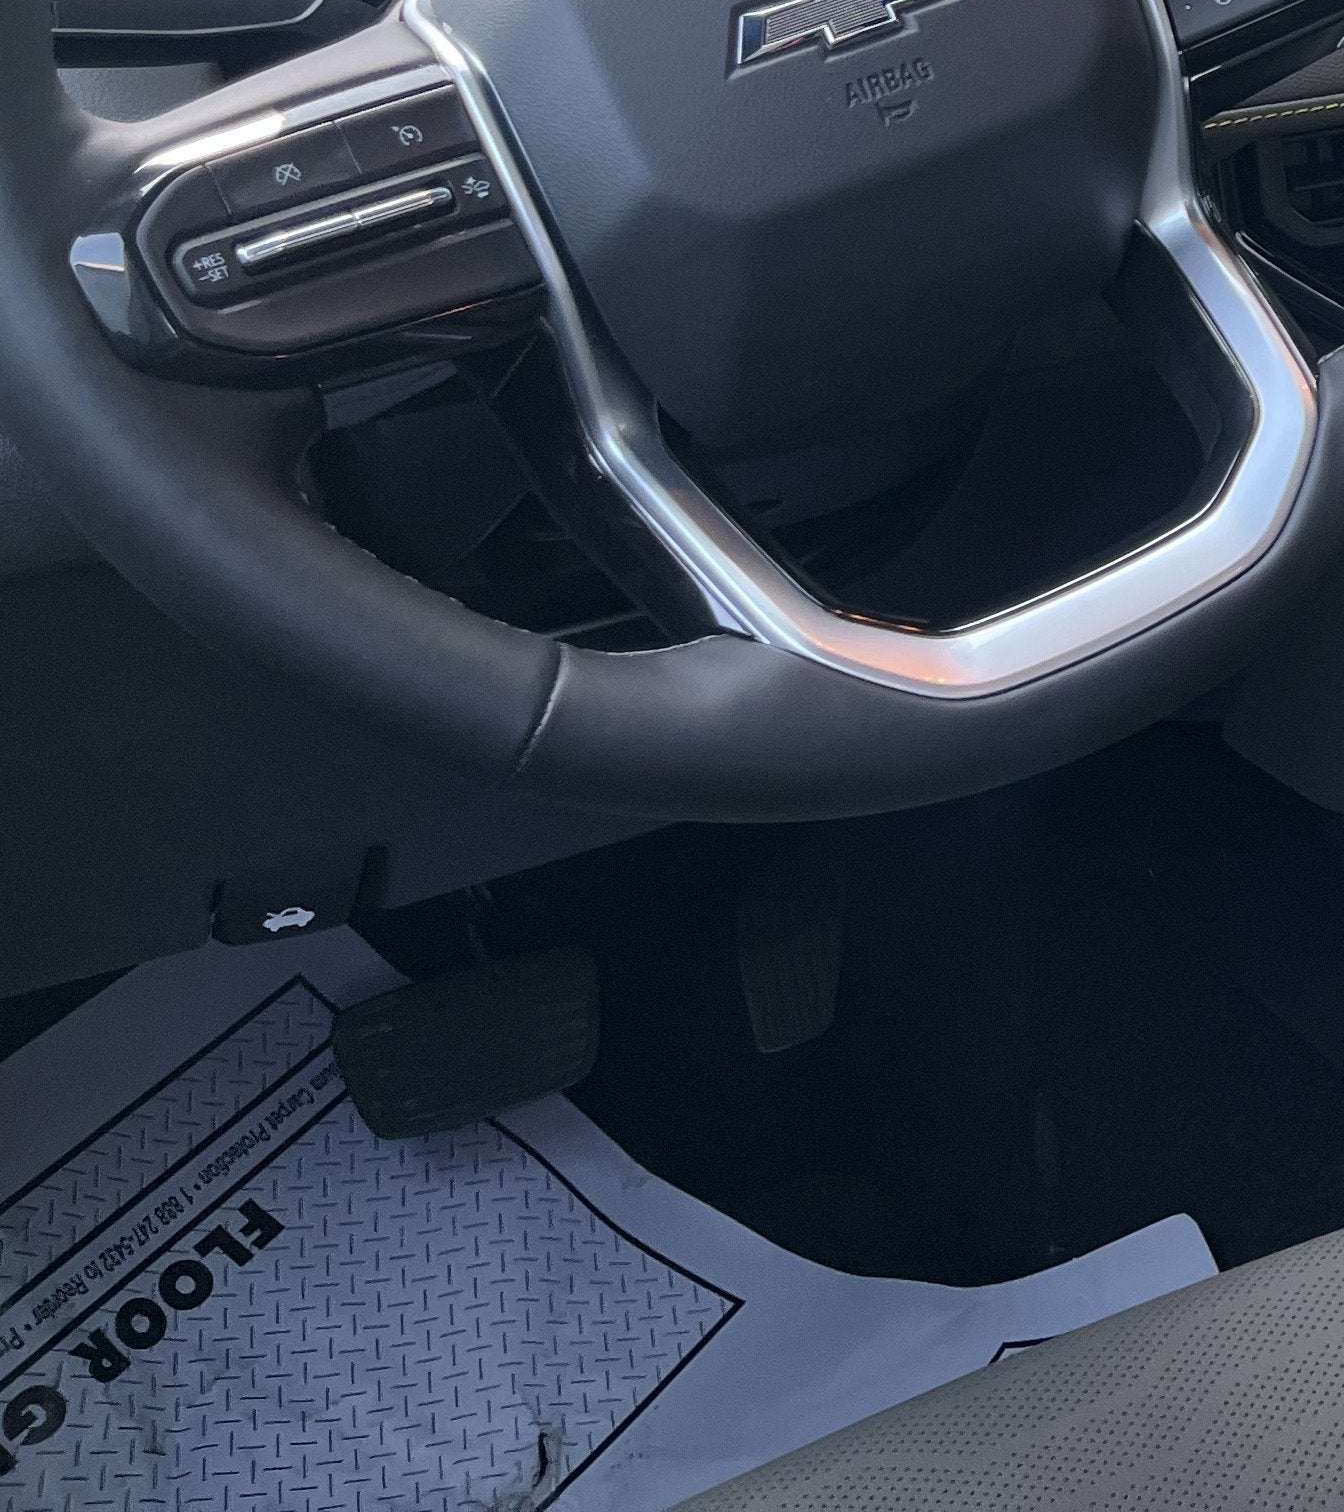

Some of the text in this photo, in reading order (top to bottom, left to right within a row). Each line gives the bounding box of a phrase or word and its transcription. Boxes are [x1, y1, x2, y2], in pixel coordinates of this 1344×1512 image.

[845, 58, 935, 108] AIRBAG
[266, 1087, 315, 1132] Carpet
[198, 1123, 272, 1186] Protection
[68, 1197, 286, 1383] FLOOR
